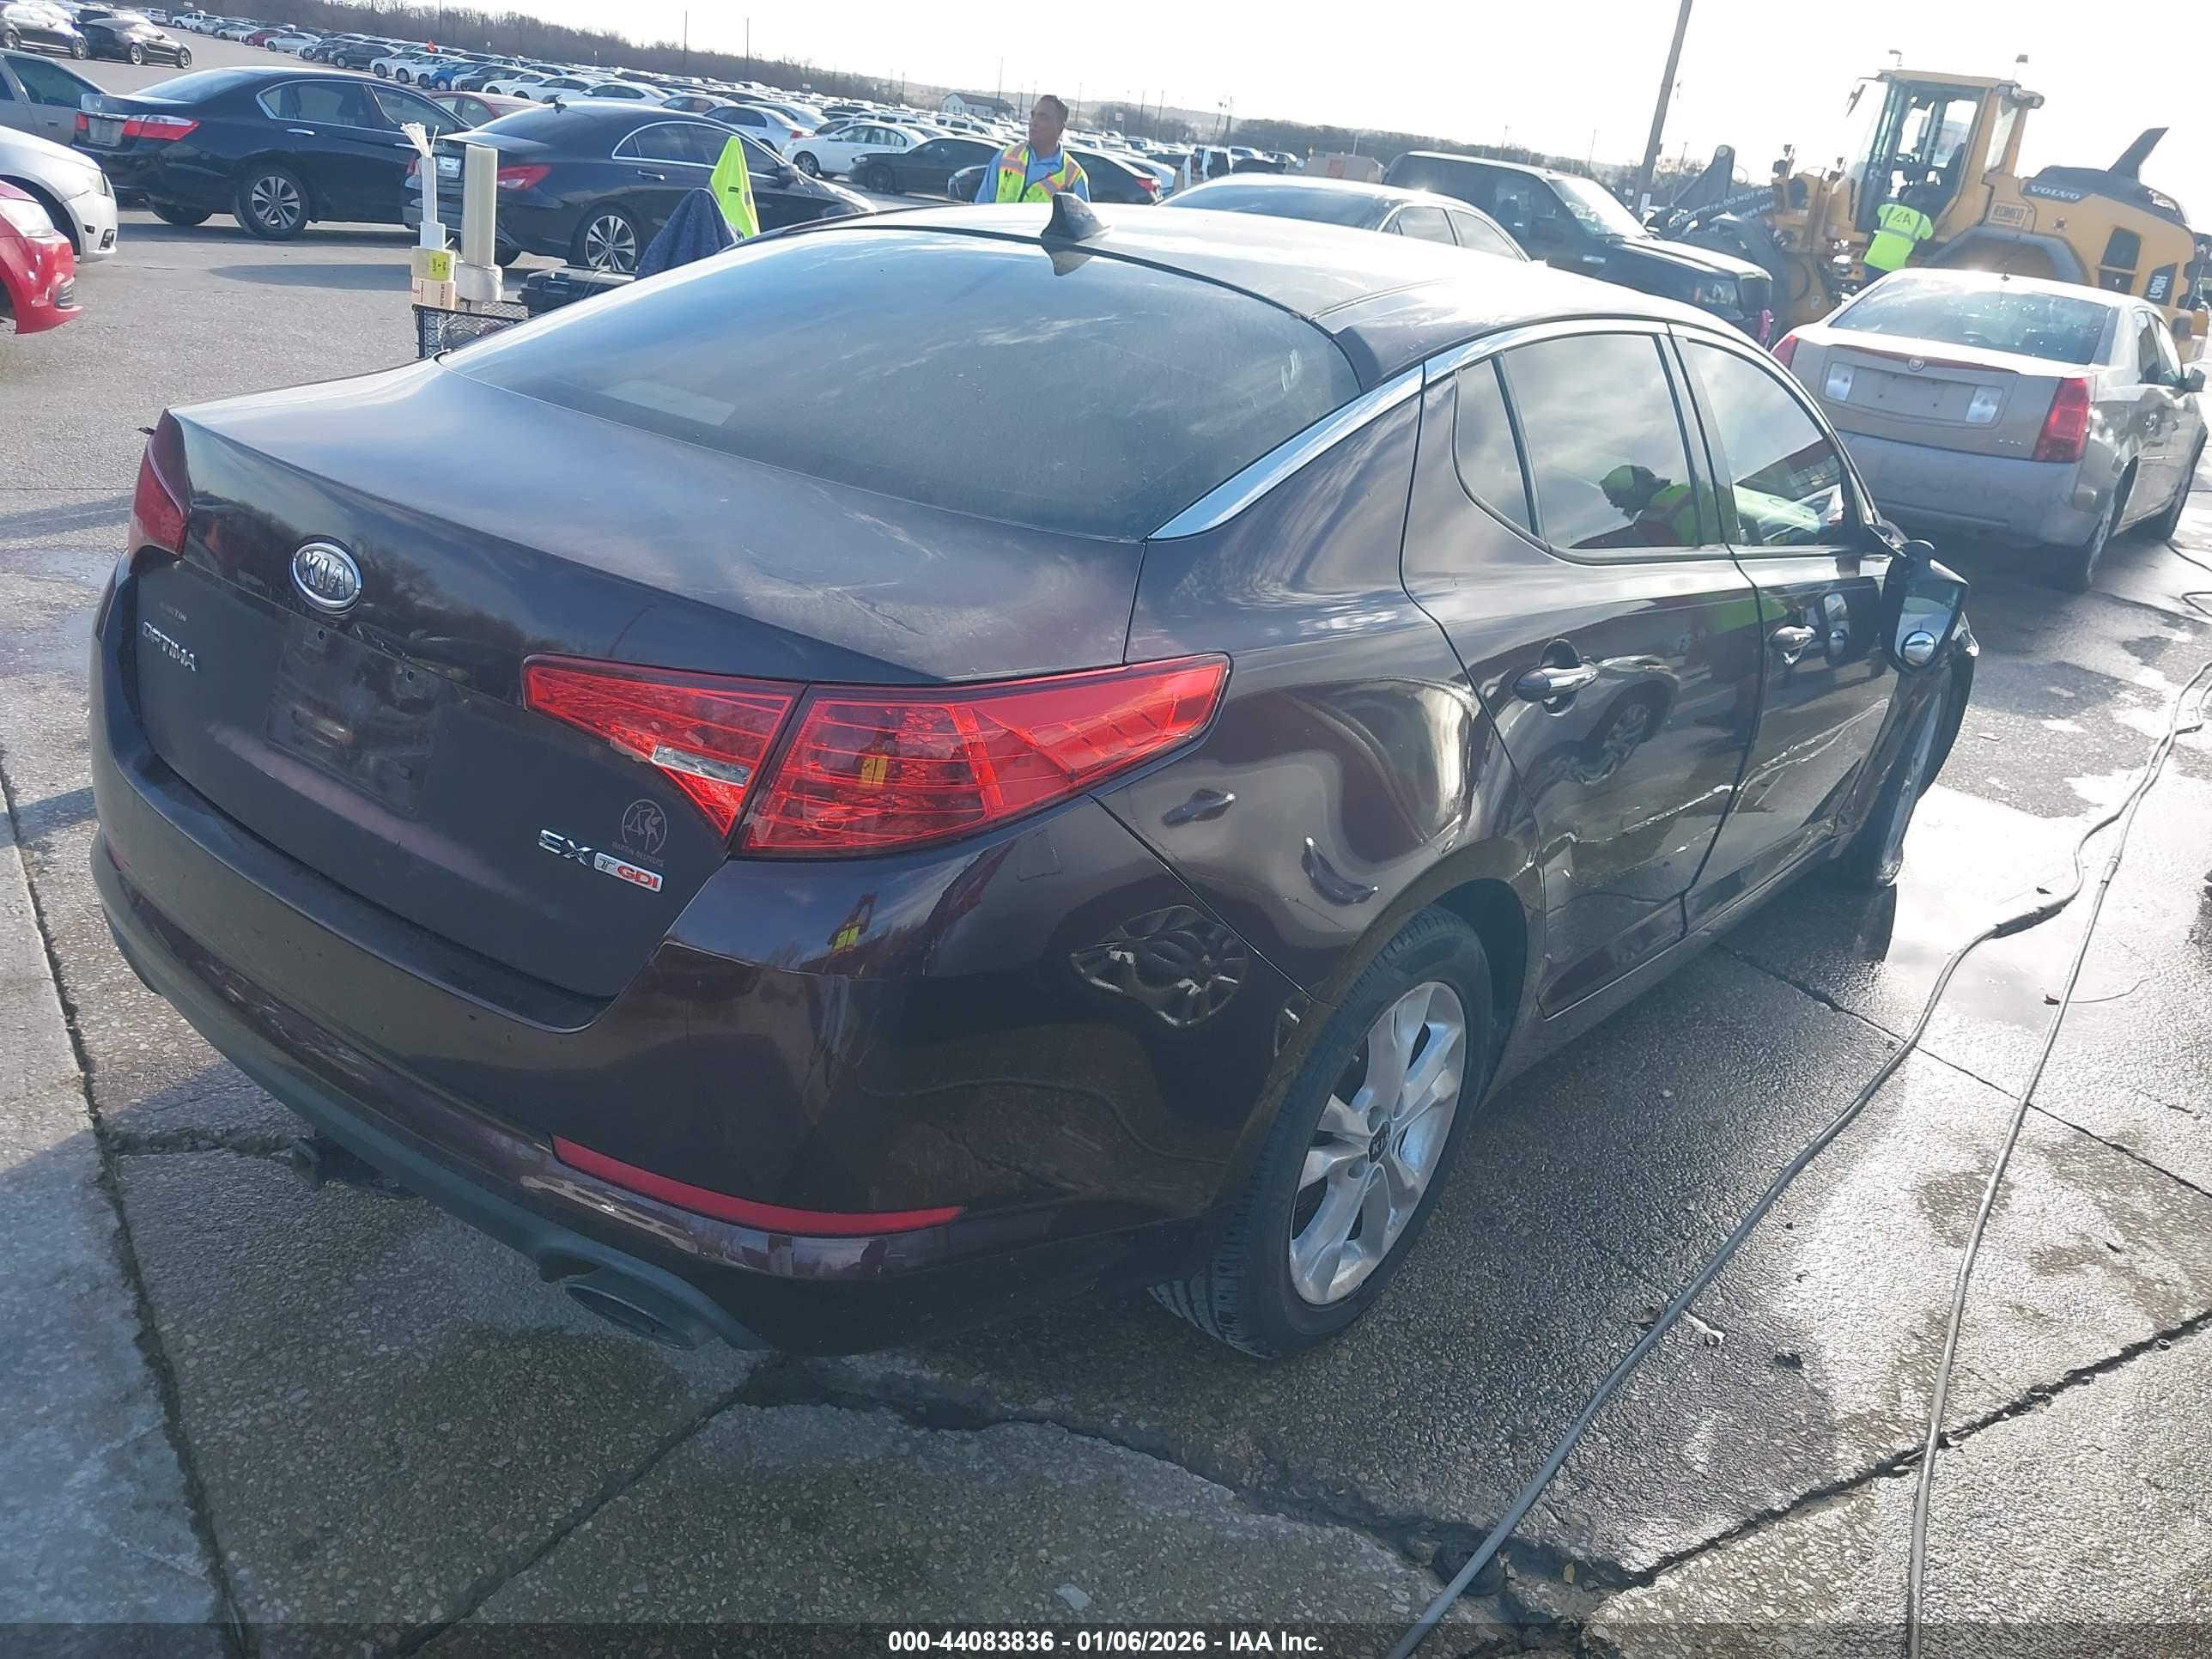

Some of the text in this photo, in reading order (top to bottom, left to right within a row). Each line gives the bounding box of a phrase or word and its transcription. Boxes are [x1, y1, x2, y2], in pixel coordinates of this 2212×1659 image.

[2030, 185, 2081, 200] VOLVO
[1993, 204, 2025, 220] ROMCO
[2148, 275, 2168, 299] L90H
[301, 551, 346, 599] KIA
[142, 621, 198, 672] OPTIMA
[538, 829, 595, 867] EX
